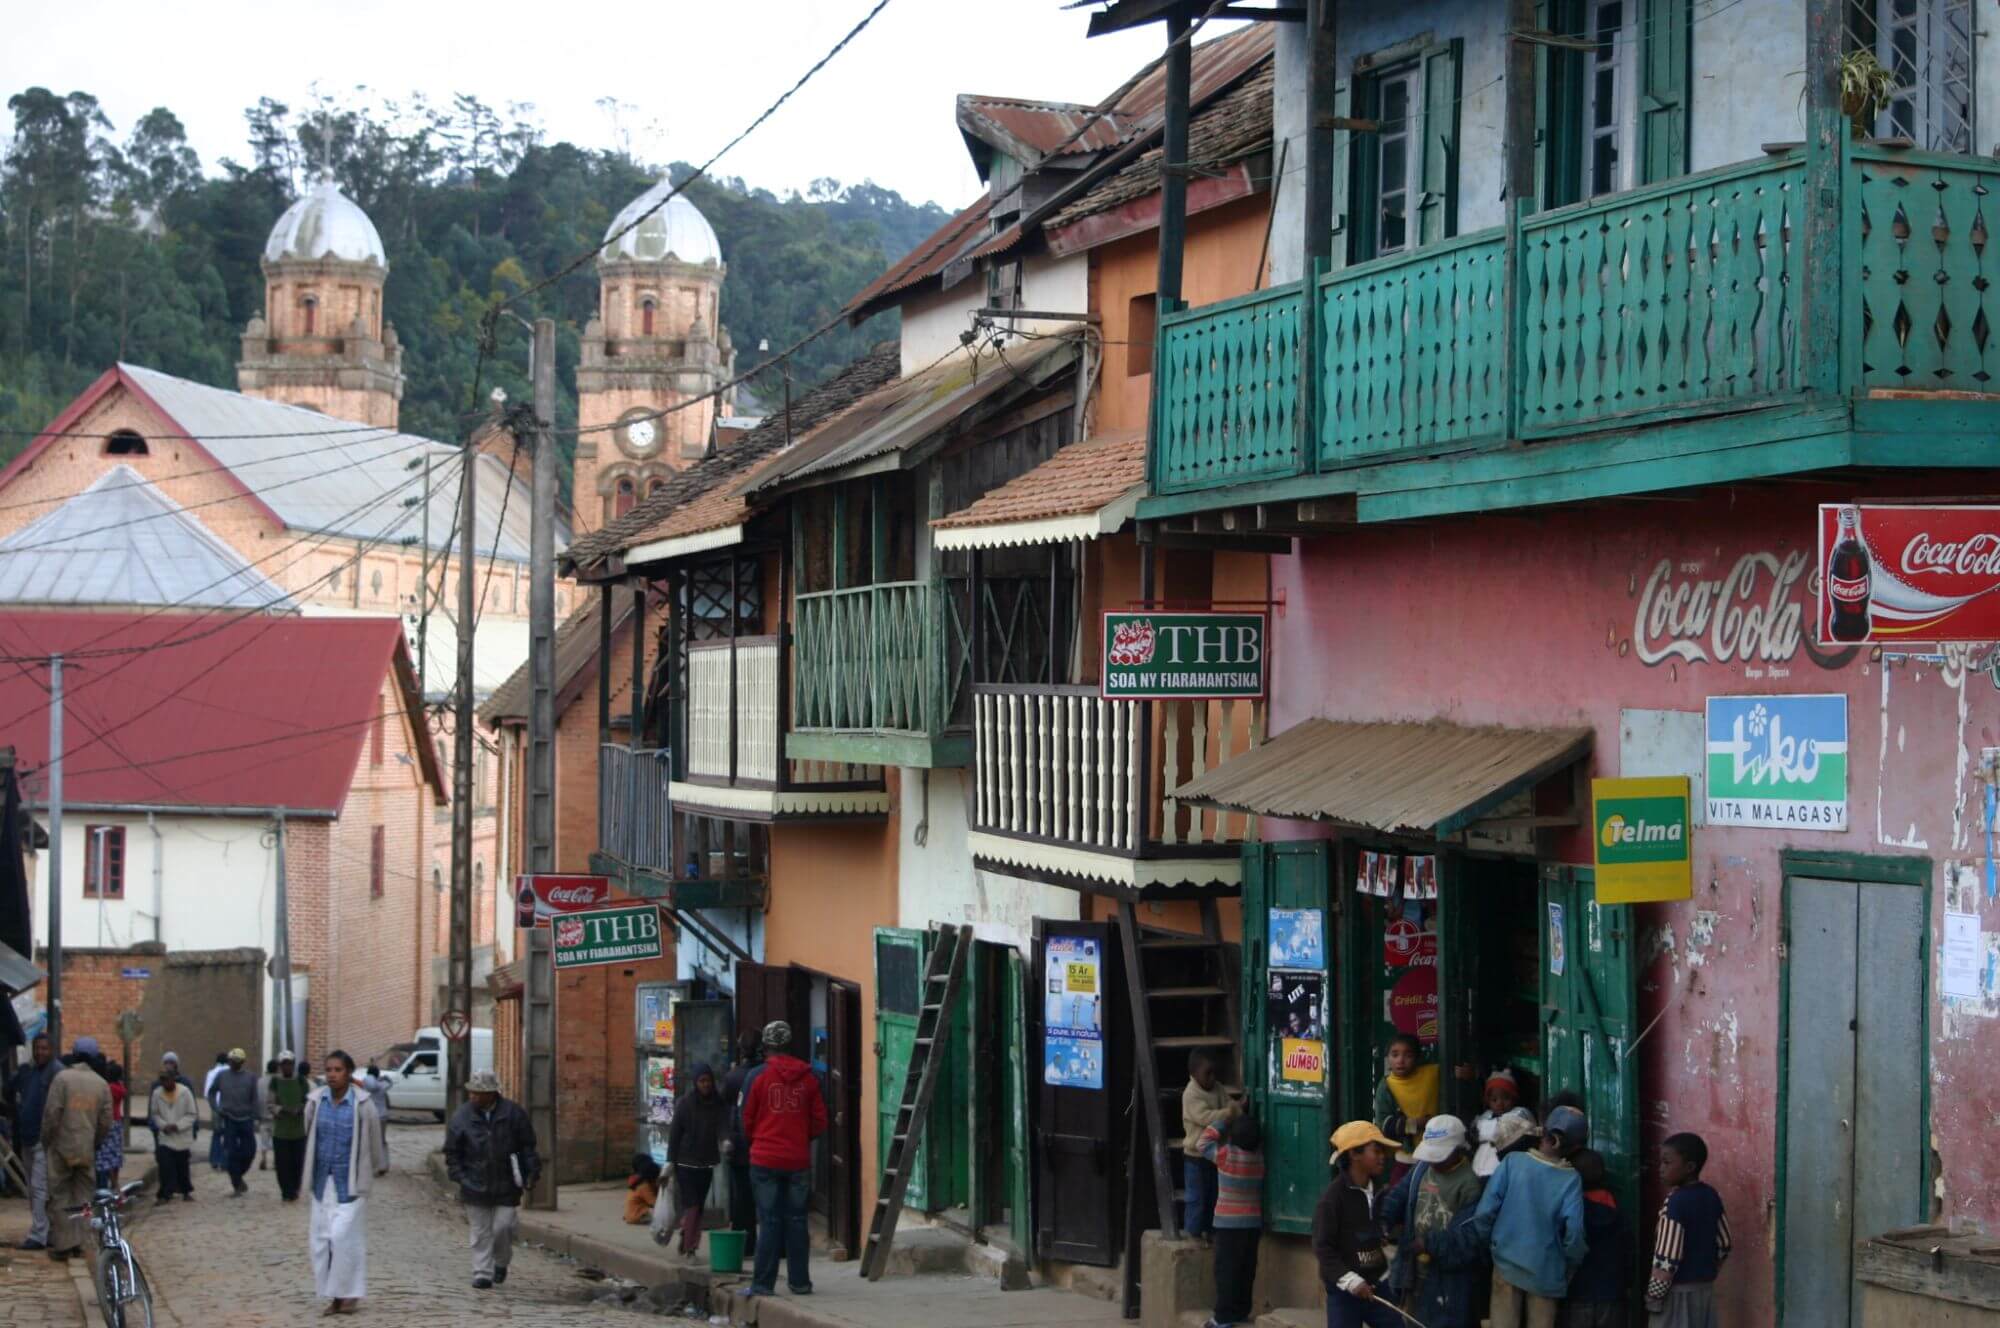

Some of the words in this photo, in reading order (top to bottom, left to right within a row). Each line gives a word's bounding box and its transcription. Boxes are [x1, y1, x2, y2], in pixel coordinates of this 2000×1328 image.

[1159, 626, 1260, 664] THB
[1109, 672, 1137, 688] SOA
[1140, 672, 1157, 688] NY
[1160, 672, 1258, 688] FIARAHANTSIKA
[1733, 704, 1819, 785] tiko
[1710, 803, 1742, 818] VITA
[1752, 804, 1843, 823] MALAGASY
[1610, 819, 1682, 843] Telma
[586, 913, 657, 943] THB
[557, 952, 575, 963] SOA
[576, 950, 589, 961] NY
[1285, 1053, 1318, 1070] JUMBO
